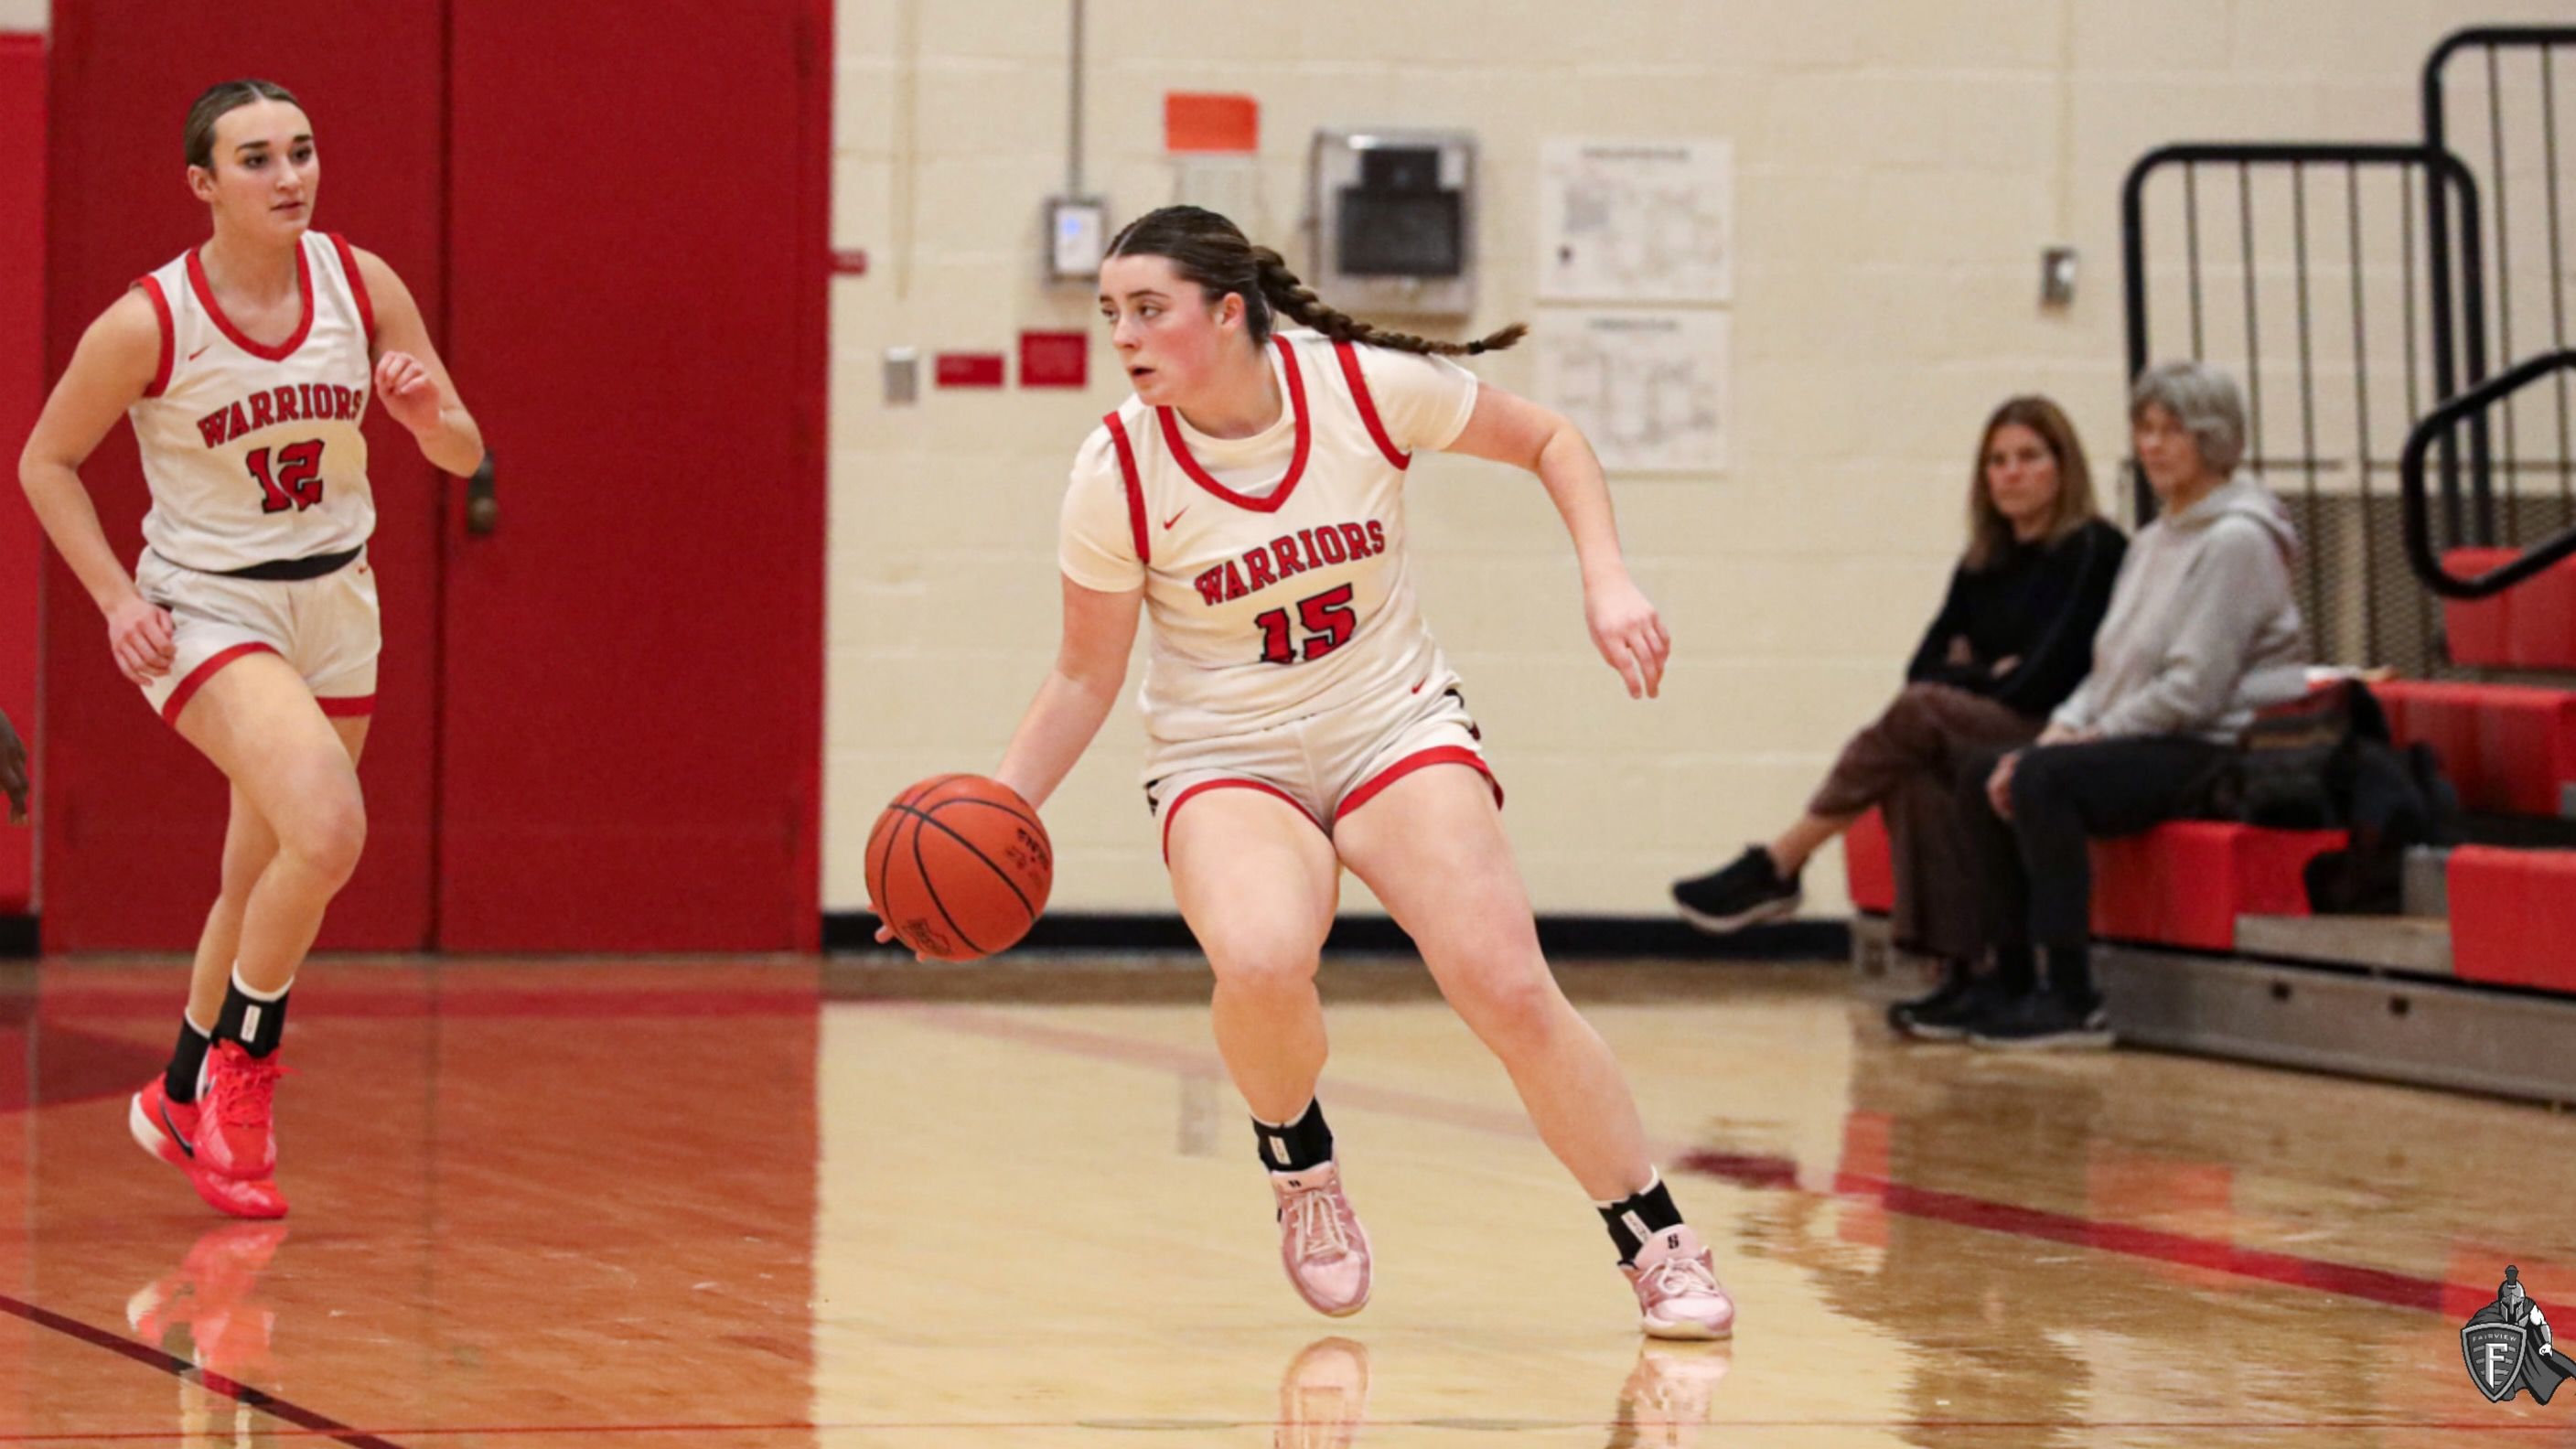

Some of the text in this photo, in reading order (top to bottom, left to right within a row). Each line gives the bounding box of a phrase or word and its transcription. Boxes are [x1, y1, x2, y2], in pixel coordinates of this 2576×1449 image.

[197, 383, 363, 449] WARRIORS
[246, 439, 325, 513] 12
[1194, 520, 1385, 606] WARRIORS
[1254, 582, 1356, 665] 15
